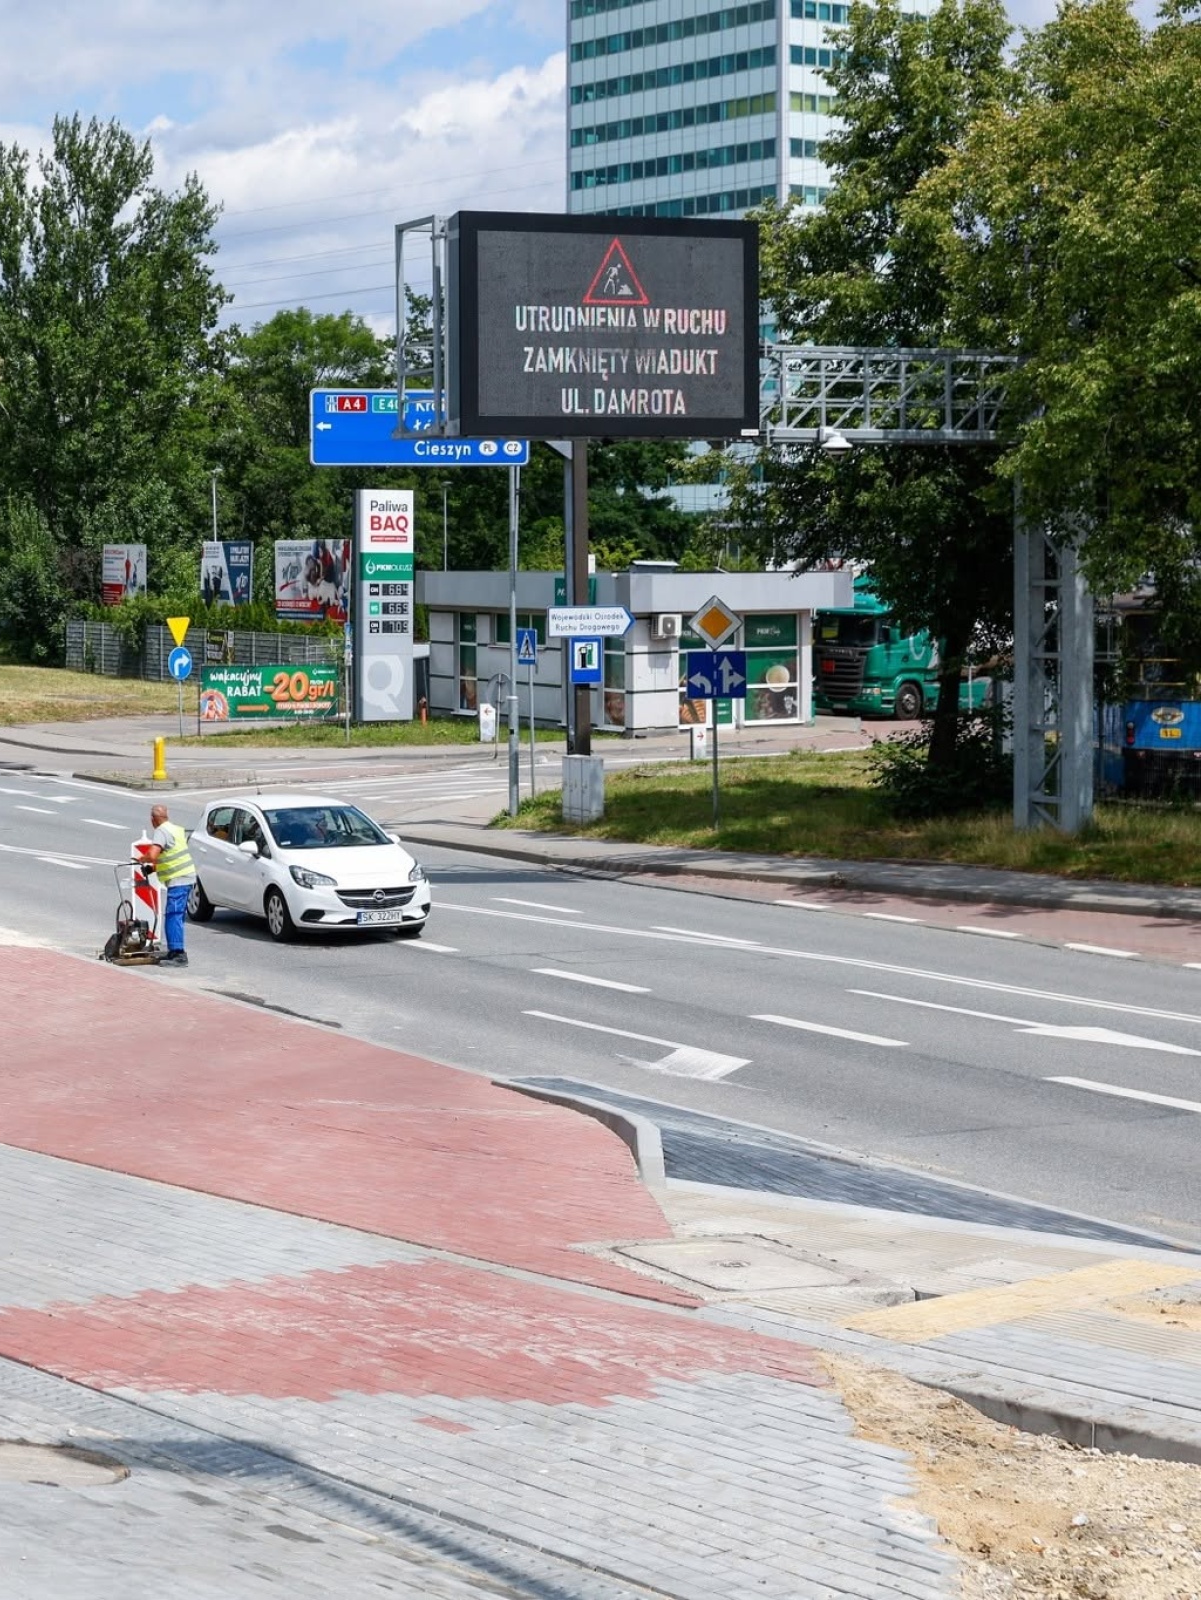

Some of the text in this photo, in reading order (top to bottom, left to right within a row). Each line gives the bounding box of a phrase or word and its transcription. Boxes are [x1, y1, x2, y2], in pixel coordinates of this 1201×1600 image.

[515, 305, 727, 335] UTRUDNIENIA W RUCHU
[523, 347, 718, 381] ZAMKNIĘTY WIADUKT
[561, 388, 686, 415] UL. DAMROTA
[414, 442, 518, 459] Cieszyn PL CZ
[370, 500, 408, 512] Paliwa
[370, 515, 408, 533] BAQ
[580, 624, 620, 632] Drogowego
[210, 669, 262, 686] wakacyjny
[227, 686, 262, 697] RABAT
